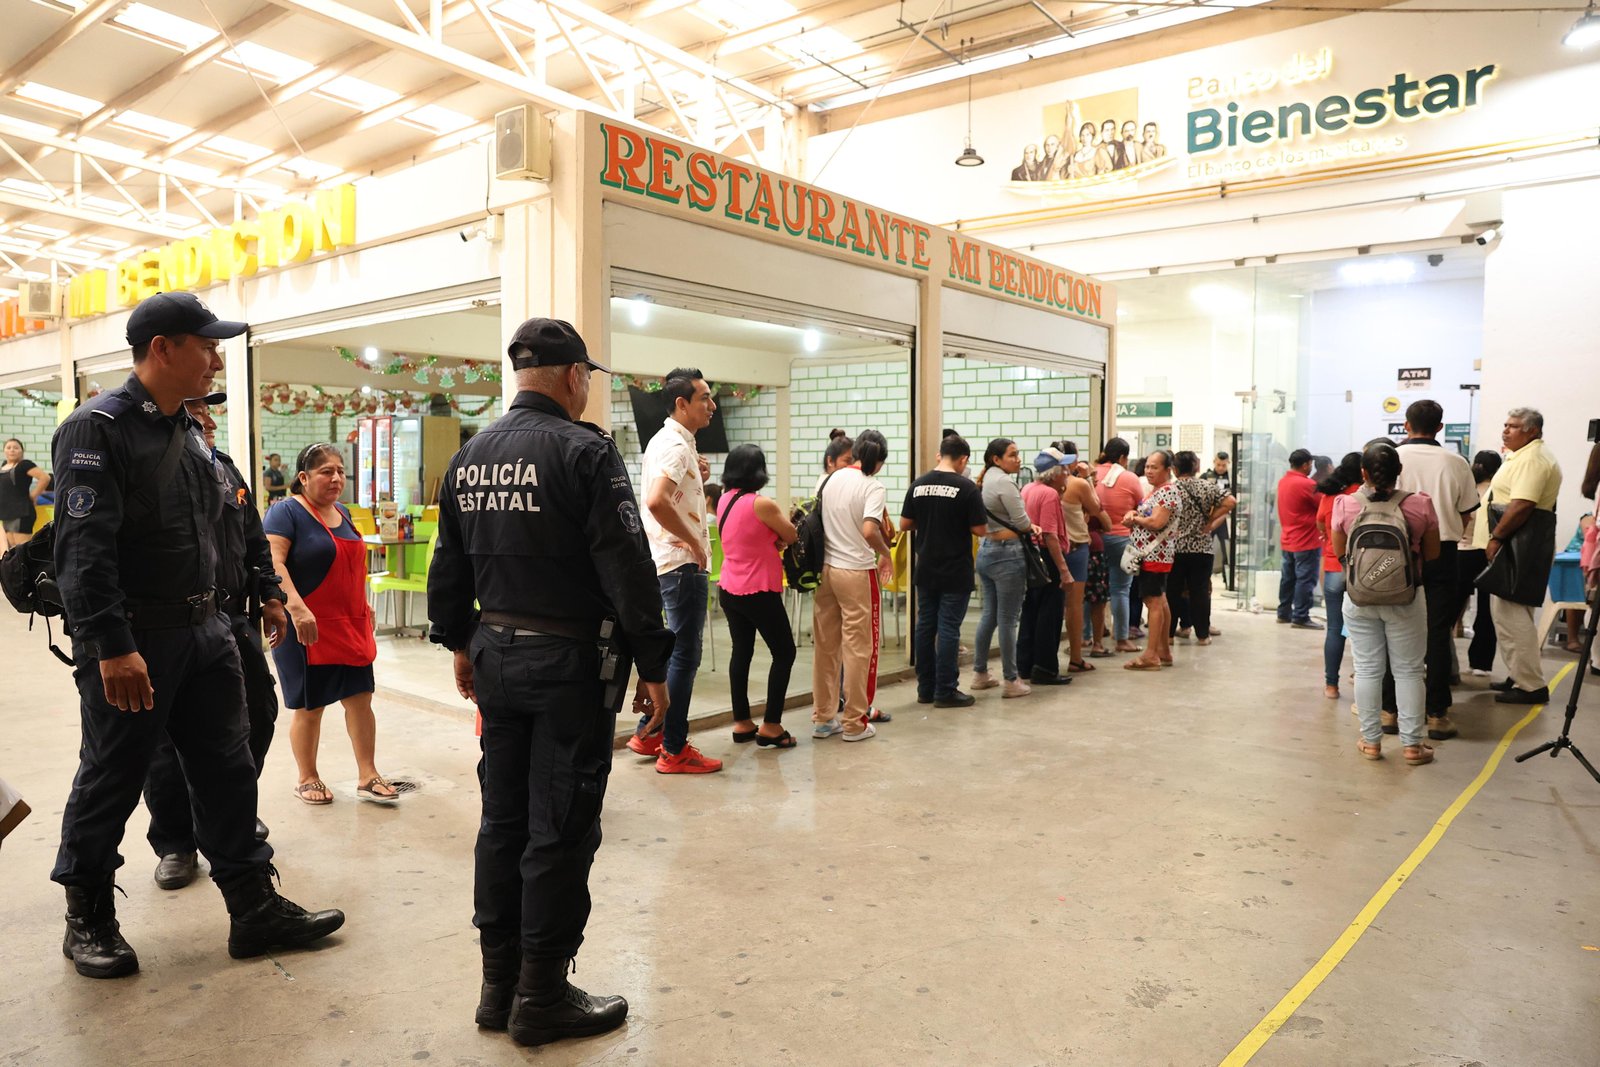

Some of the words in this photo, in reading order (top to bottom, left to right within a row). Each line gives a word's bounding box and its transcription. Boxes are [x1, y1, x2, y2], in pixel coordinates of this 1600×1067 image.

[1187, 64, 1496, 154] Bienestar
[600, 122, 931, 271] RESTAURANTE
[948, 236, 981, 285] MI
[988, 249, 1102, 319] BENDICION
[117, 183, 356, 307] BENDICION
[1401, 369, 1428, 379] ATM
[1129, 404, 1138, 416] 2
[1390, 425, 1407, 434] AT
[71, 459, 101, 467] ESTATAL
[73, 452, 101, 461] POLICÍA
[456, 458, 539, 489] POLICÍA
[456, 491, 541, 513] ESTATAL
